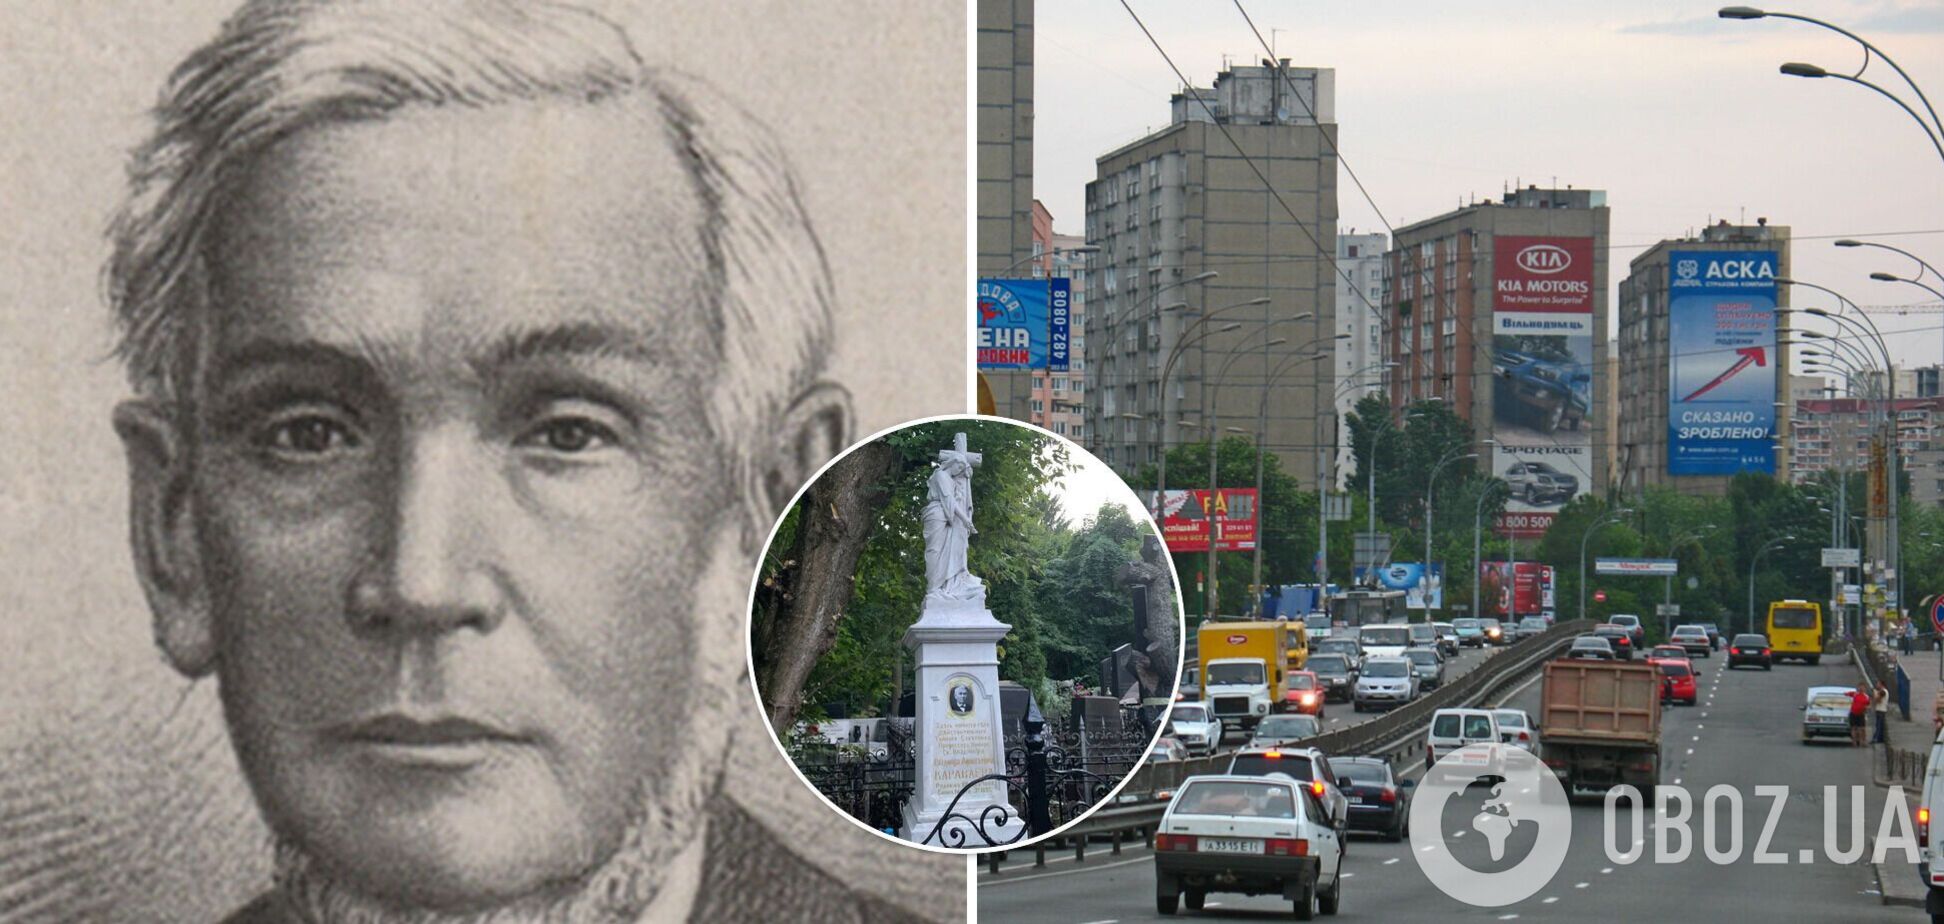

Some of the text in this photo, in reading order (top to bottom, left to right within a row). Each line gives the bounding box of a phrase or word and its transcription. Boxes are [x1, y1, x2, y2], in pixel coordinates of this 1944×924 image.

[1526, 251, 1562, 267] KIA
[1498, 280, 1589, 293] KIA MOTORS
[977, 283, 1020, 312] ДОВА
[1503, 295, 1516, 303] The
[1517, 296, 1541, 304] Power
[1053, 290, 1067, 359] 482-0808
[1682, 411, 1754, 423] СКАЗАНО
[1679, 427, 1769, 439] ЗРОБЛЕНО!
[1501, 446, 1583, 455] SPORTAGE
[1506, 516, 1528, 528] 800
